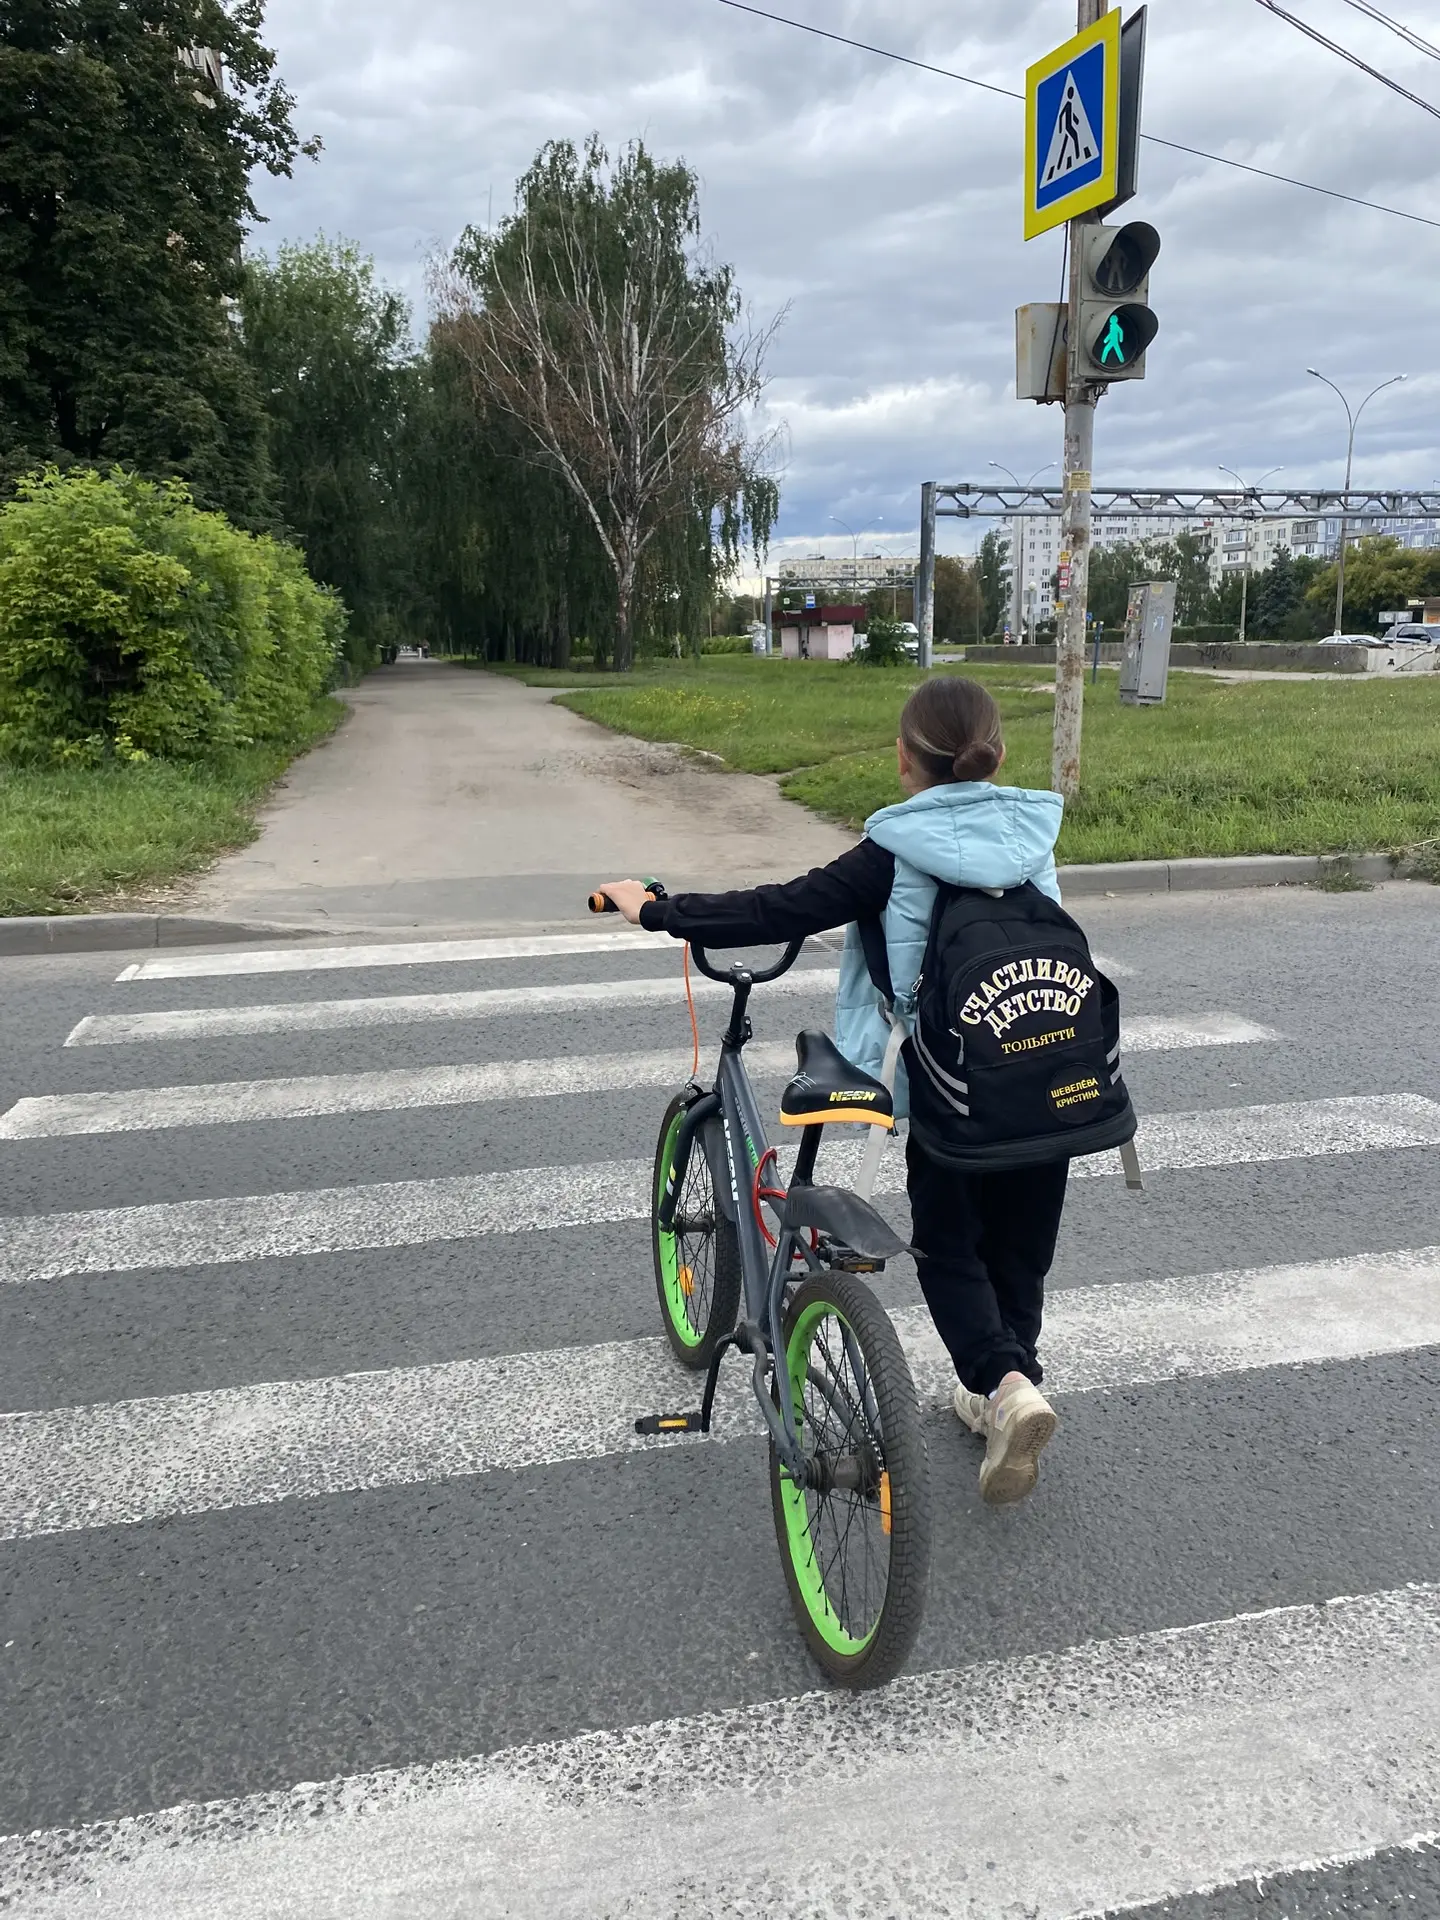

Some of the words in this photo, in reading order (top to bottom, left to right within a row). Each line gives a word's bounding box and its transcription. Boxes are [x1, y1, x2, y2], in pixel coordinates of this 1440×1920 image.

[959, 958, 1095, 1026] СЧАСТЛИВОЕ
[983, 988, 1082, 1039] ДЕТСТВО
[1001, 1026, 1076, 1055] ТОЛЬЯТТИ
[829, 1090, 877, 1102] NEON
[1055, 1088, 1100, 1109] КРИСТИНА
